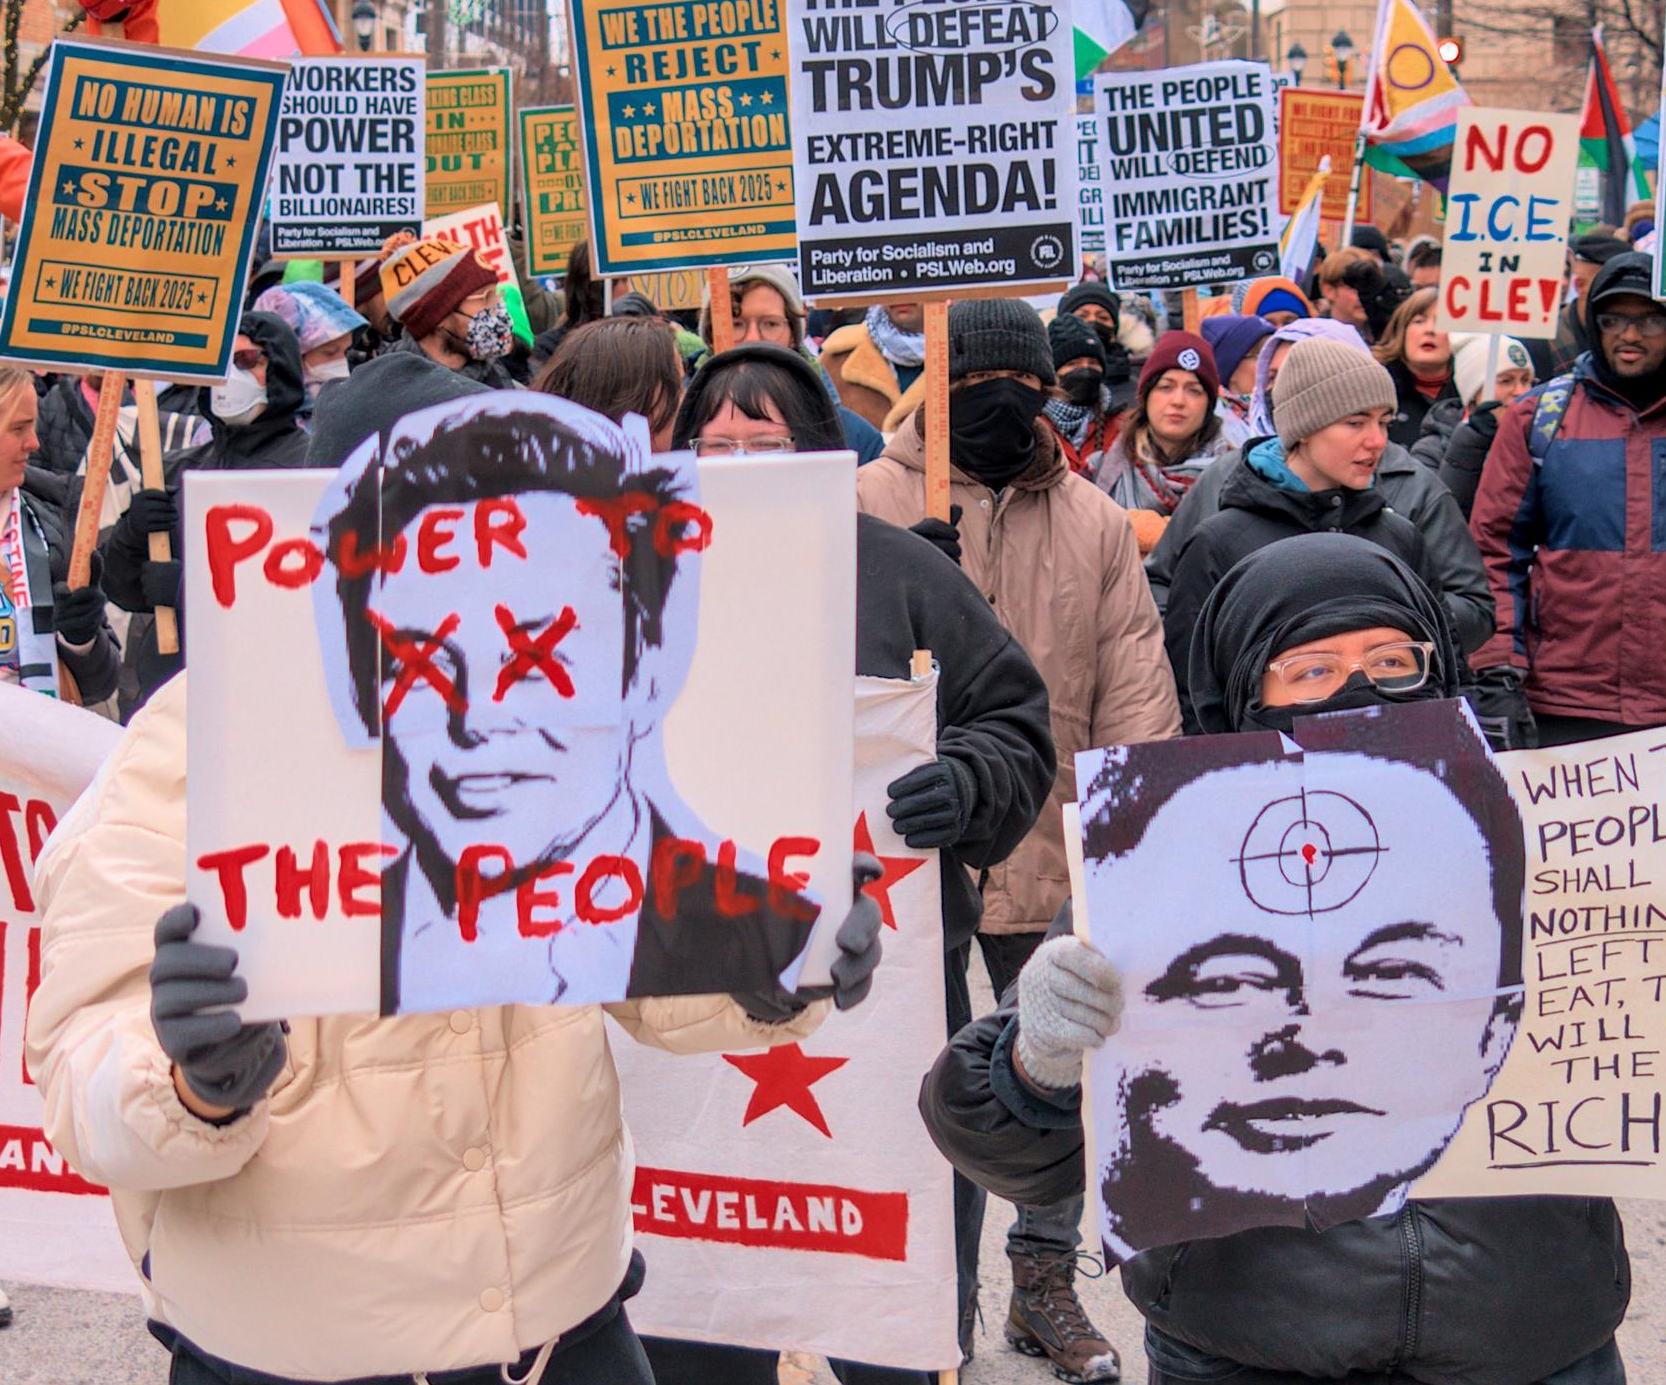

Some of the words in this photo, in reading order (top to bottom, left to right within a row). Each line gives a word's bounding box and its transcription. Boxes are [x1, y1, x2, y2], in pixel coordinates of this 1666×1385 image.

[602, 11, 638, 46] WE
[643, 7, 687, 41] THE
[802, 16, 898, 53] WILL
[909, 6, 1052, 48] DEFEAT
[286, 66, 416, 92] WORKERS
[625, 41, 761, 84] REJECT
[802, 49, 1056, 113] TRUMP'S
[79, 81, 117, 119] NO
[121, 86, 216, 132] HUMAN
[221, 99, 249, 136] IS
[282, 96, 359, 115] SHOULD
[366, 96, 417, 115] HAVE
[661, 86, 734, 123] MASS
[1104, 84, 1155, 112] THE
[1162, 73, 1261, 107] PEOPLE
[280, 117, 415, 153] POWER
[436, 112, 465, 129] IN
[615, 113, 786, 158] DEPORTATION
[1107, 103, 1265, 156] UNITED
[91, 129, 217, 175] ILLEGAL
[807, 120, 1058, 164] EXTREME-RIGHT
[1465, 124, 1554, 174] NO
[280, 163, 350, 194] NOT
[357, 163, 415, 193] THE
[1110, 154, 1168, 181] WILL
[1174, 144, 1267, 175] DEFEND
[77, 172, 216, 219] STOP
[280, 197, 415, 217] BILLIONAIRES!
[640, 181, 659, 210] WE
[664, 178, 699, 208] FIGHT
[702, 175, 735, 205] BACK
[740, 173, 773, 203] 2025
[809, 158, 1057, 226] AGENDA!
[1113, 179, 1269, 218] IMMIGRANT
[50, 206, 103, 244] MASS
[106, 212, 226, 256] DEPORTATION
[278, 227, 302, 238] Party
[303, 227, 316, 236] for
[318, 226, 365, 236] Socialism
[366, 226, 380, 236] and
[654, 224, 766, 243] @PSLCLEVELAND
[1116, 207, 1269, 251] FAMILIES!
[1449, 193, 1564, 242] I.C.E.
[278, 238, 323, 248] Liberation
[811, 248, 853, 267] Party
[856, 245, 880, 262] for
[882, 242, 960, 260] Socialism
[963, 238, 994, 255] and
[1479, 252, 1521, 273] IN
[812, 267, 893, 286] Liberation
[916, 258, 1016, 278] PSLWeb.org
[1118, 262, 1144, 276] Party
[1146, 261, 1160, 272] for
[1162, 257, 1210, 272] Socialism
[1212, 254, 1230, 267] and
[1118, 273, 1171, 287] Liberation
[1183, 267, 1245, 283] PSLWeb.org
[59, 268, 79, 299] WE
[84, 270, 123, 303] FIGHT
[125, 275, 159, 308] BACK
[162, 279, 196, 310] 2025
[1446, 275, 1559, 323] CLE!
[61, 323, 175, 344] @PSLCLEVELAND
[576, 492, 715, 558] TO
[1522, 753, 1639, 805] WHEN
[197, 840, 393, 932] THE
[453, 836, 824, 943] PEOPLE
[1532, 859, 1652, 895] SHALL
[1538, 938, 1663, 982] LEFT
[1538, 977, 1626, 1017] EAT,
[1527, 1014, 1645, 1053] WILL
[1550, 1050, 1661, 1084] THE
[1486, 1092, 1662, 1161] RICH
[632, 1183, 864, 1237] EVELAND
